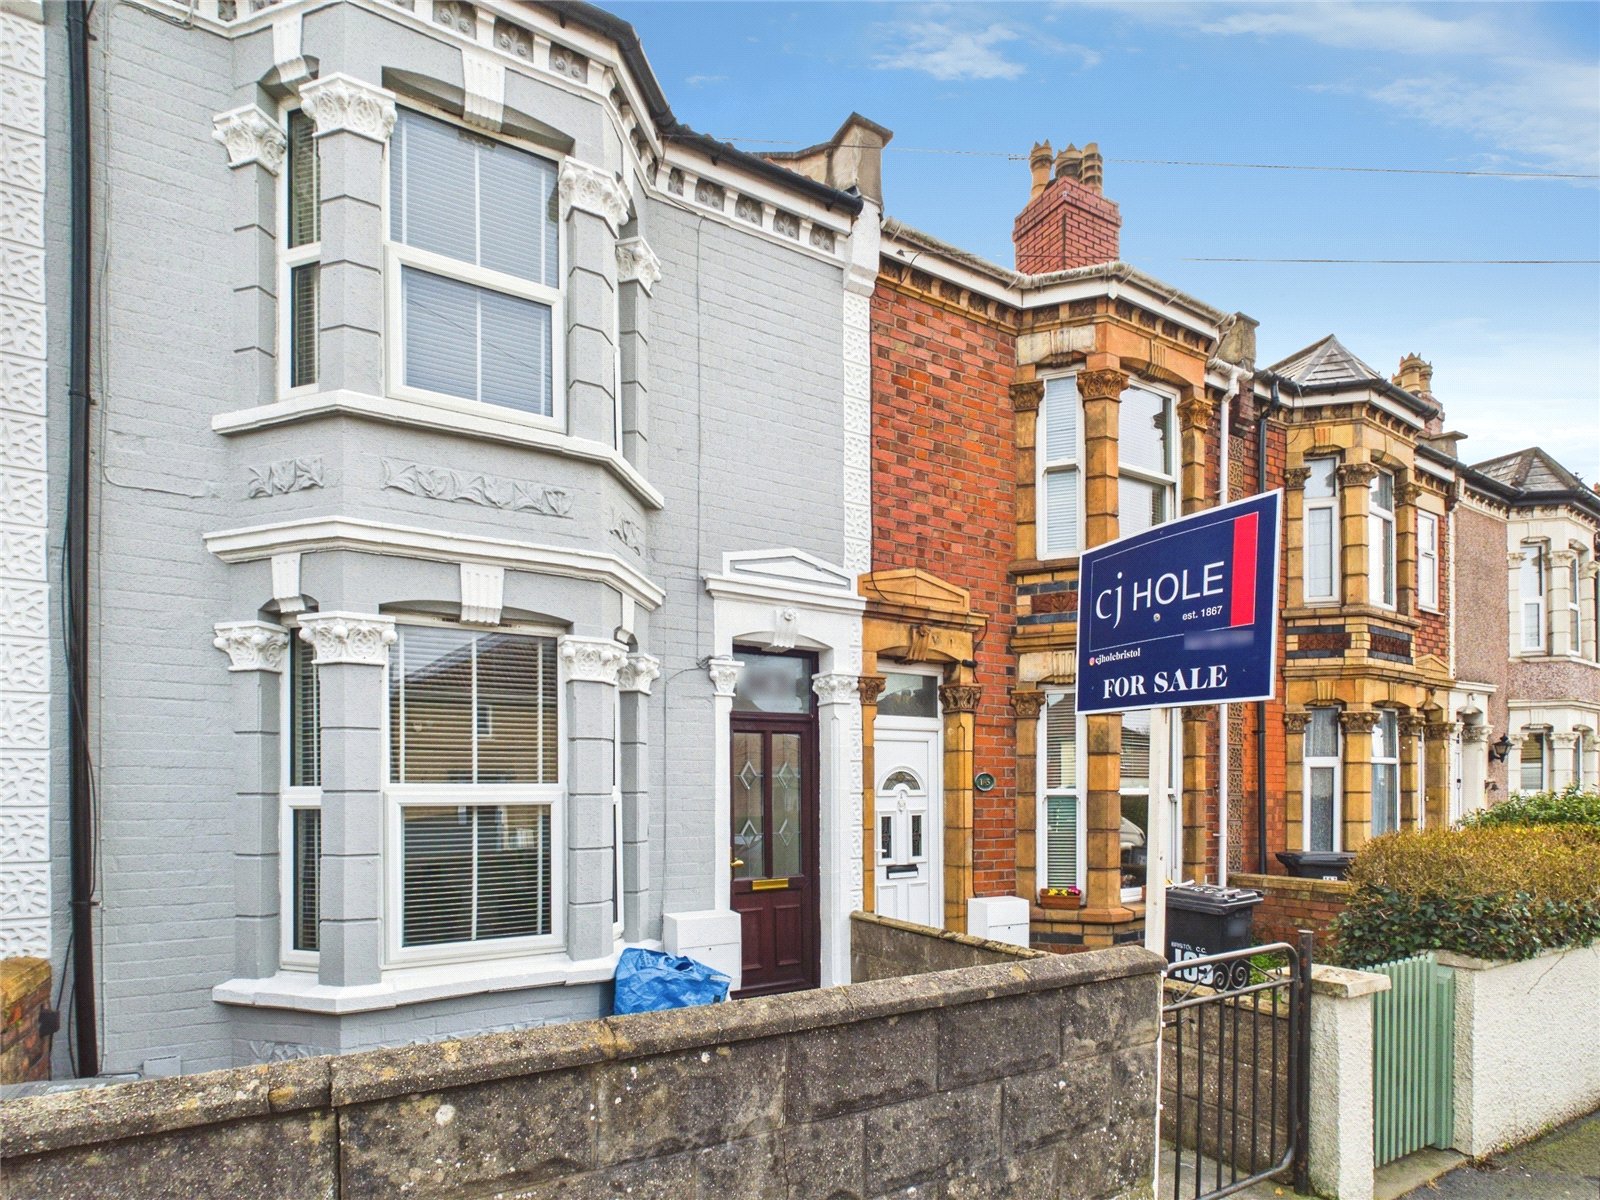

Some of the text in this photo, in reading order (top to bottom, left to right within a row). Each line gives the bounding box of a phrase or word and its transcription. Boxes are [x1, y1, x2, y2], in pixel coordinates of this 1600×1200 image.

[1095, 560, 1225, 629] cj HOLE
[1182, 605, 1223, 621] est. 1867
[1095, 647, 1141, 666] cjholebristol
[1103, 664, 1228, 699] FOR SALE
